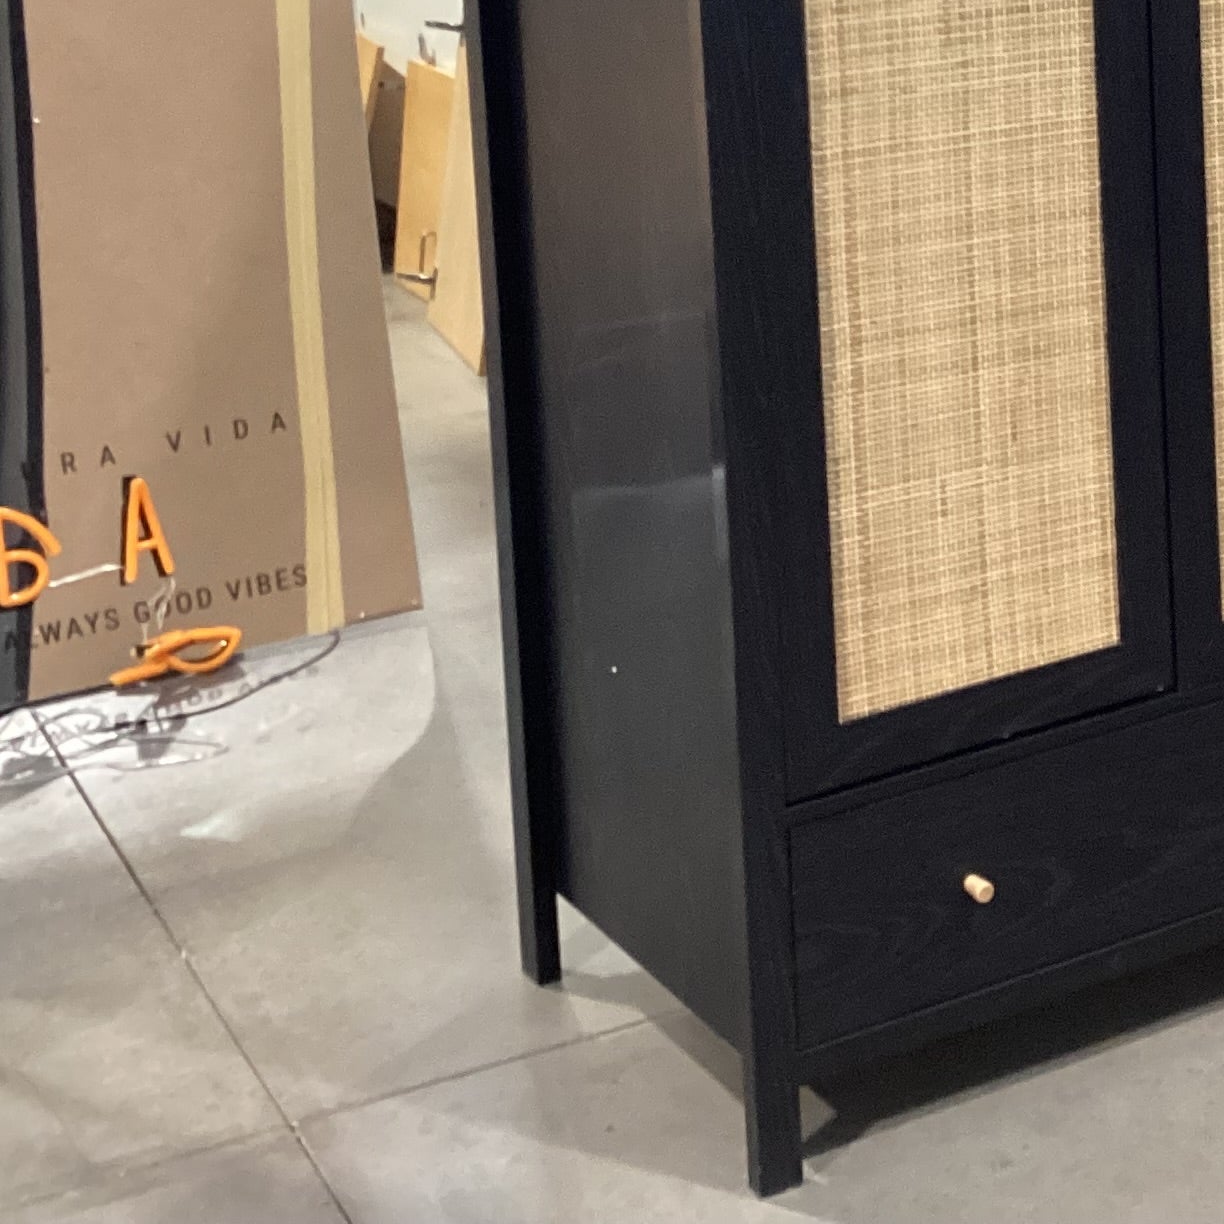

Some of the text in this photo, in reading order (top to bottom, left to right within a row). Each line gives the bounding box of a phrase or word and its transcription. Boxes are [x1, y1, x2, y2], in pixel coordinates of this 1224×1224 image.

[165, 412, 287, 452] VIDA
[133, 586, 213, 625] GOOD
[226, 565, 307, 601] VIBES
